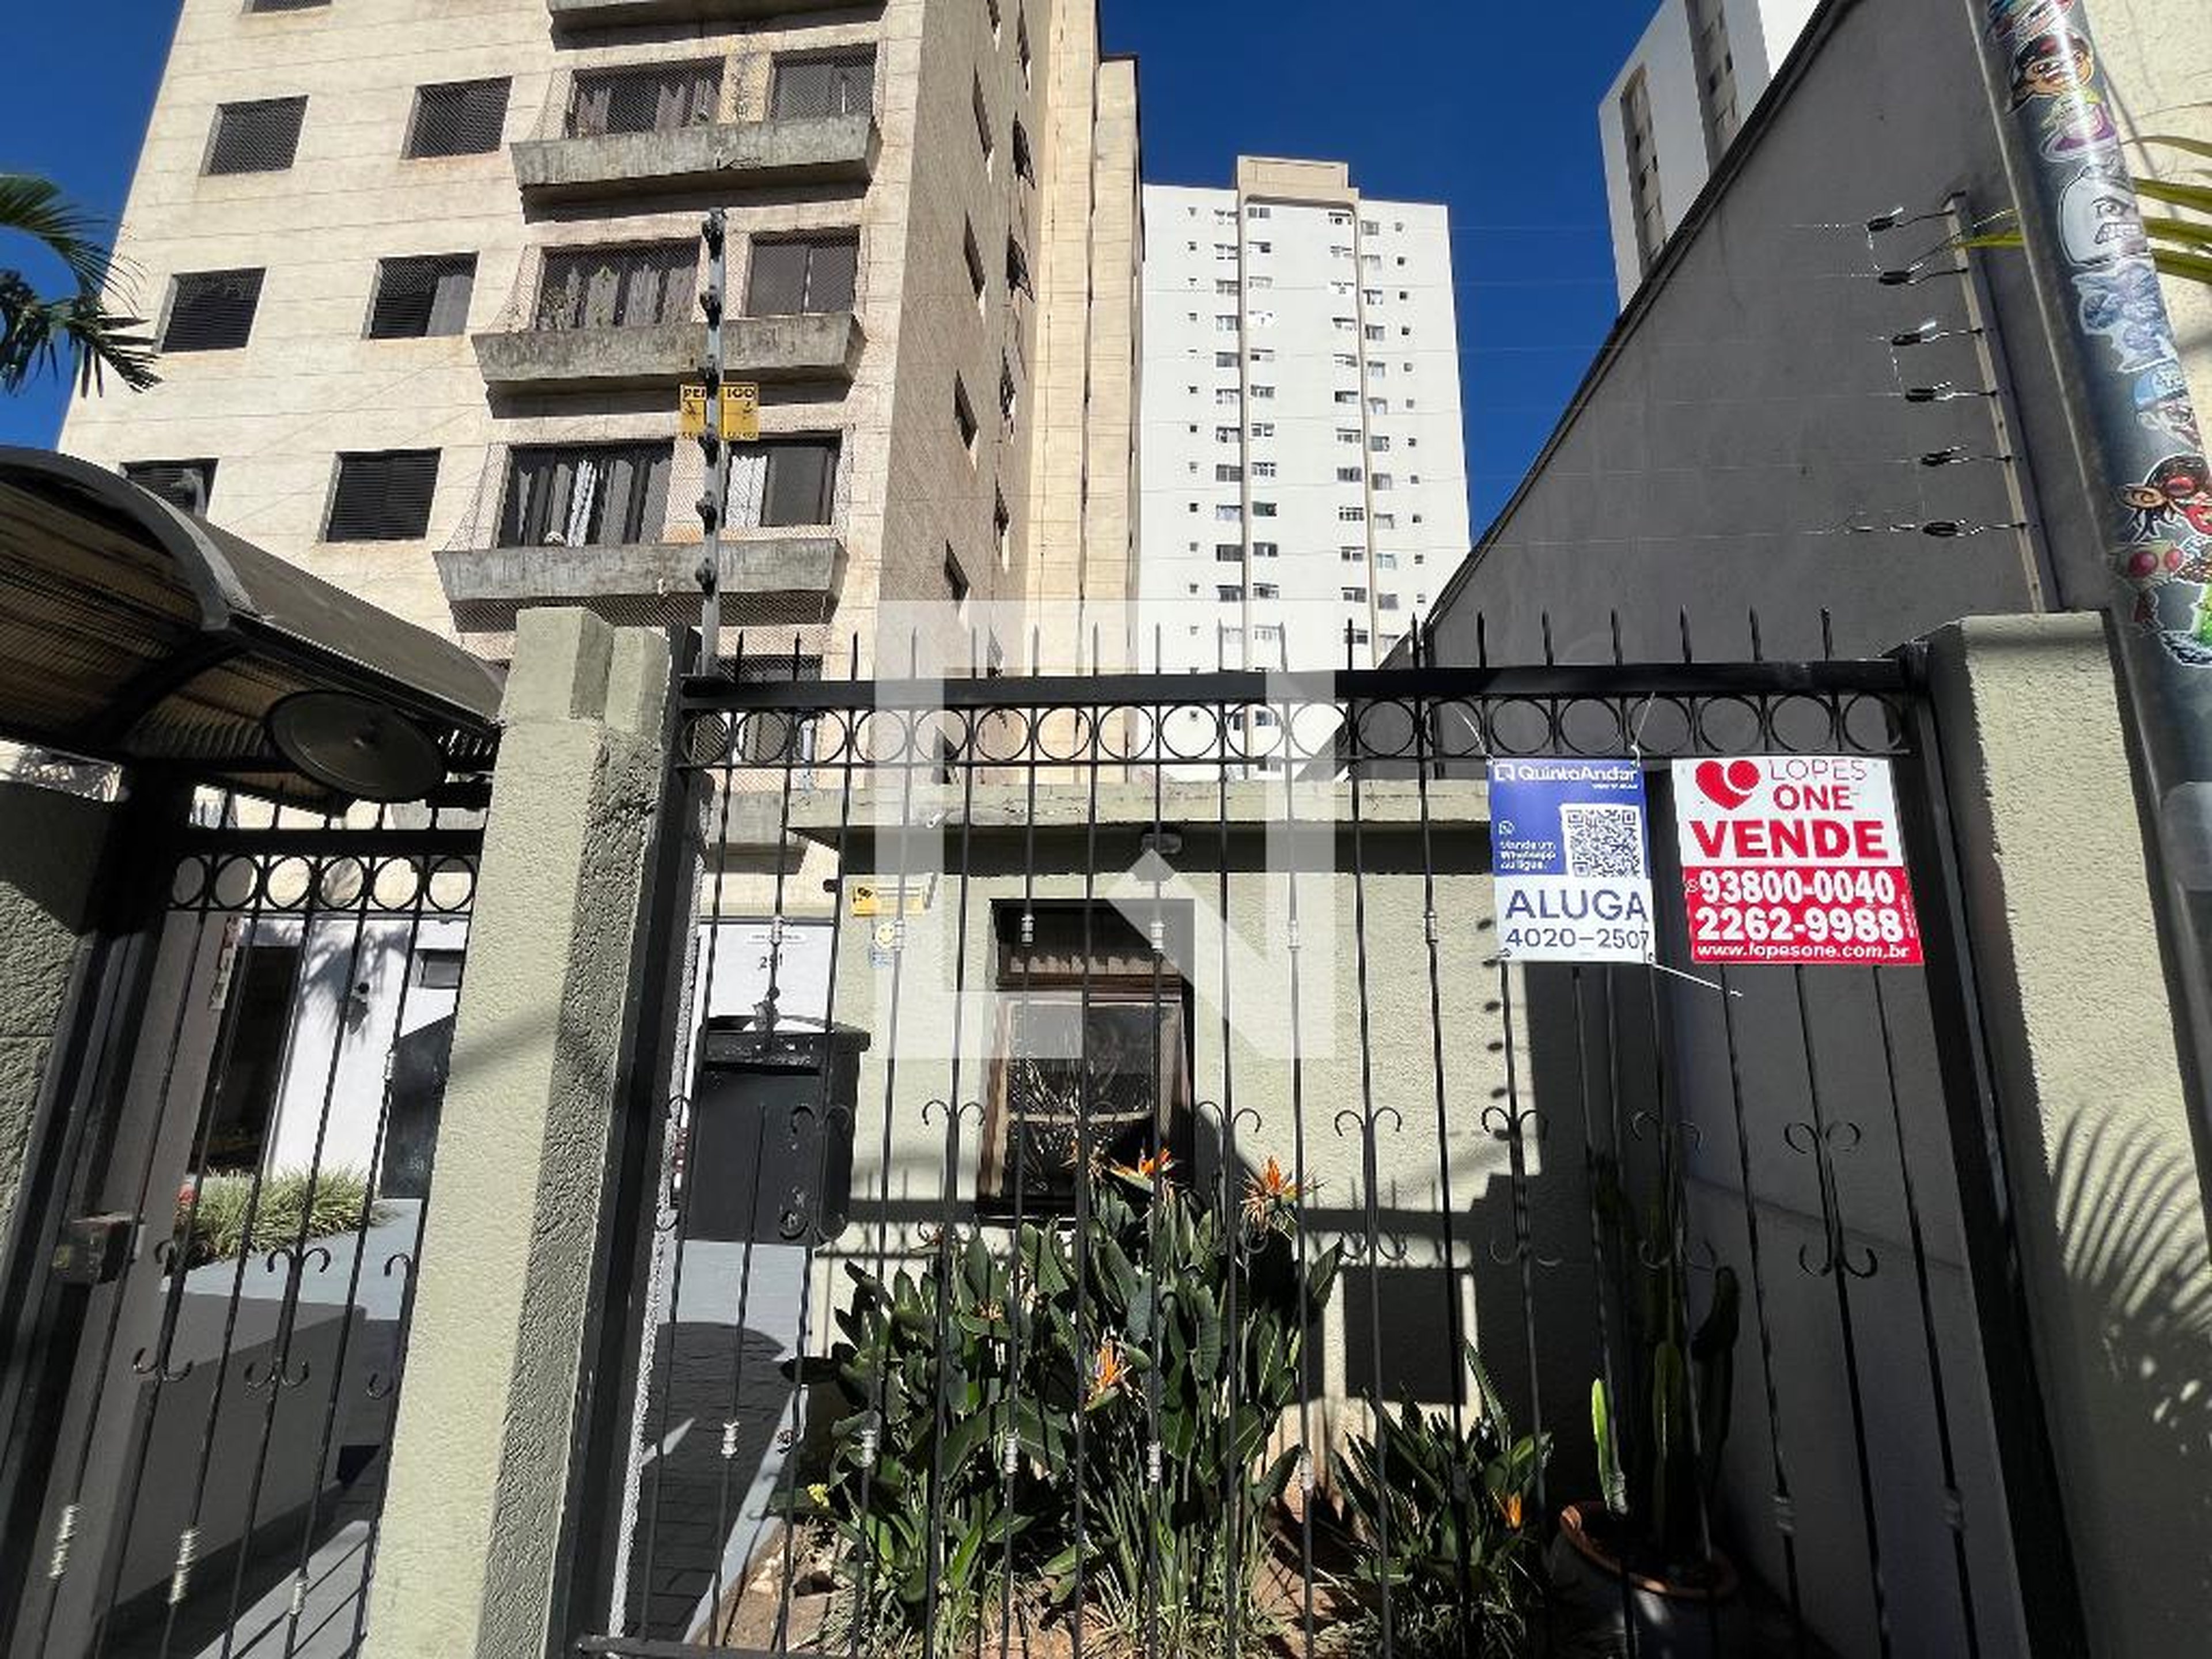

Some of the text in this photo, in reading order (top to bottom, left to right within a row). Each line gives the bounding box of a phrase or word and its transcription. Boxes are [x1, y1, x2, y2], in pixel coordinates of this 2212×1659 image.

[1518, 766, 1637, 781] QuintoAndar
[1768, 759, 1867, 781] LOPES
[1773, 784, 1854, 811] ONE
[1689, 819, 1888, 858] VENDE
[1699, 869, 1896, 904] 93800-0040
[1505, 889, 1649, 922] ALUGA
[1695, 907, 1903, 942] 2262-9988
[1505, 928, 1649, 949] 4020-2507
[1697, 942, 1910, 960] www.lopesone.com.br
